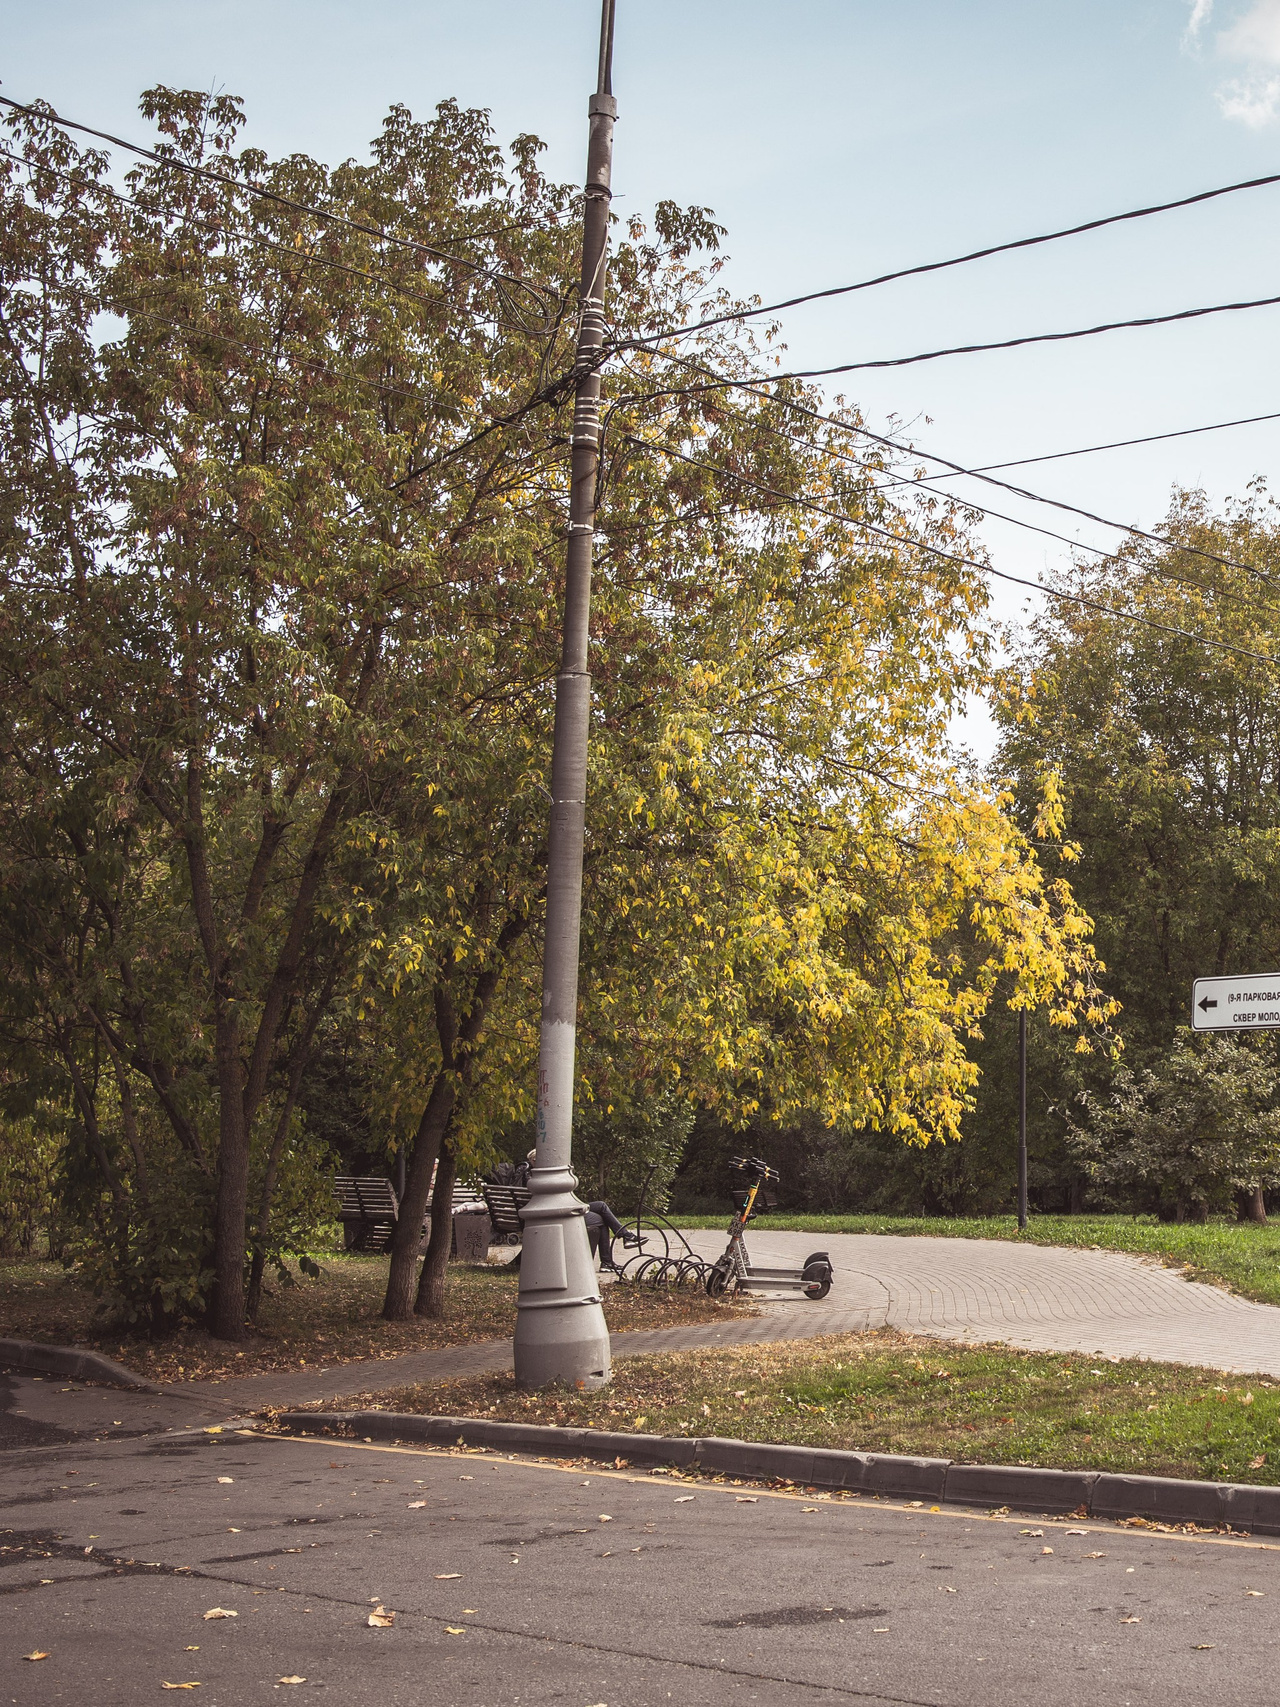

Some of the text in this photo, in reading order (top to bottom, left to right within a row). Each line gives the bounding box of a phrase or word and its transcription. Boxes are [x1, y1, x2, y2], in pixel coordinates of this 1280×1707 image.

[1227, 993, 1241, 1004] (9-Я
[1243, 992, 1280, 1002] ПАРКОВАЯ
[1233, 1013, 1256, 1022] СКВЕР
